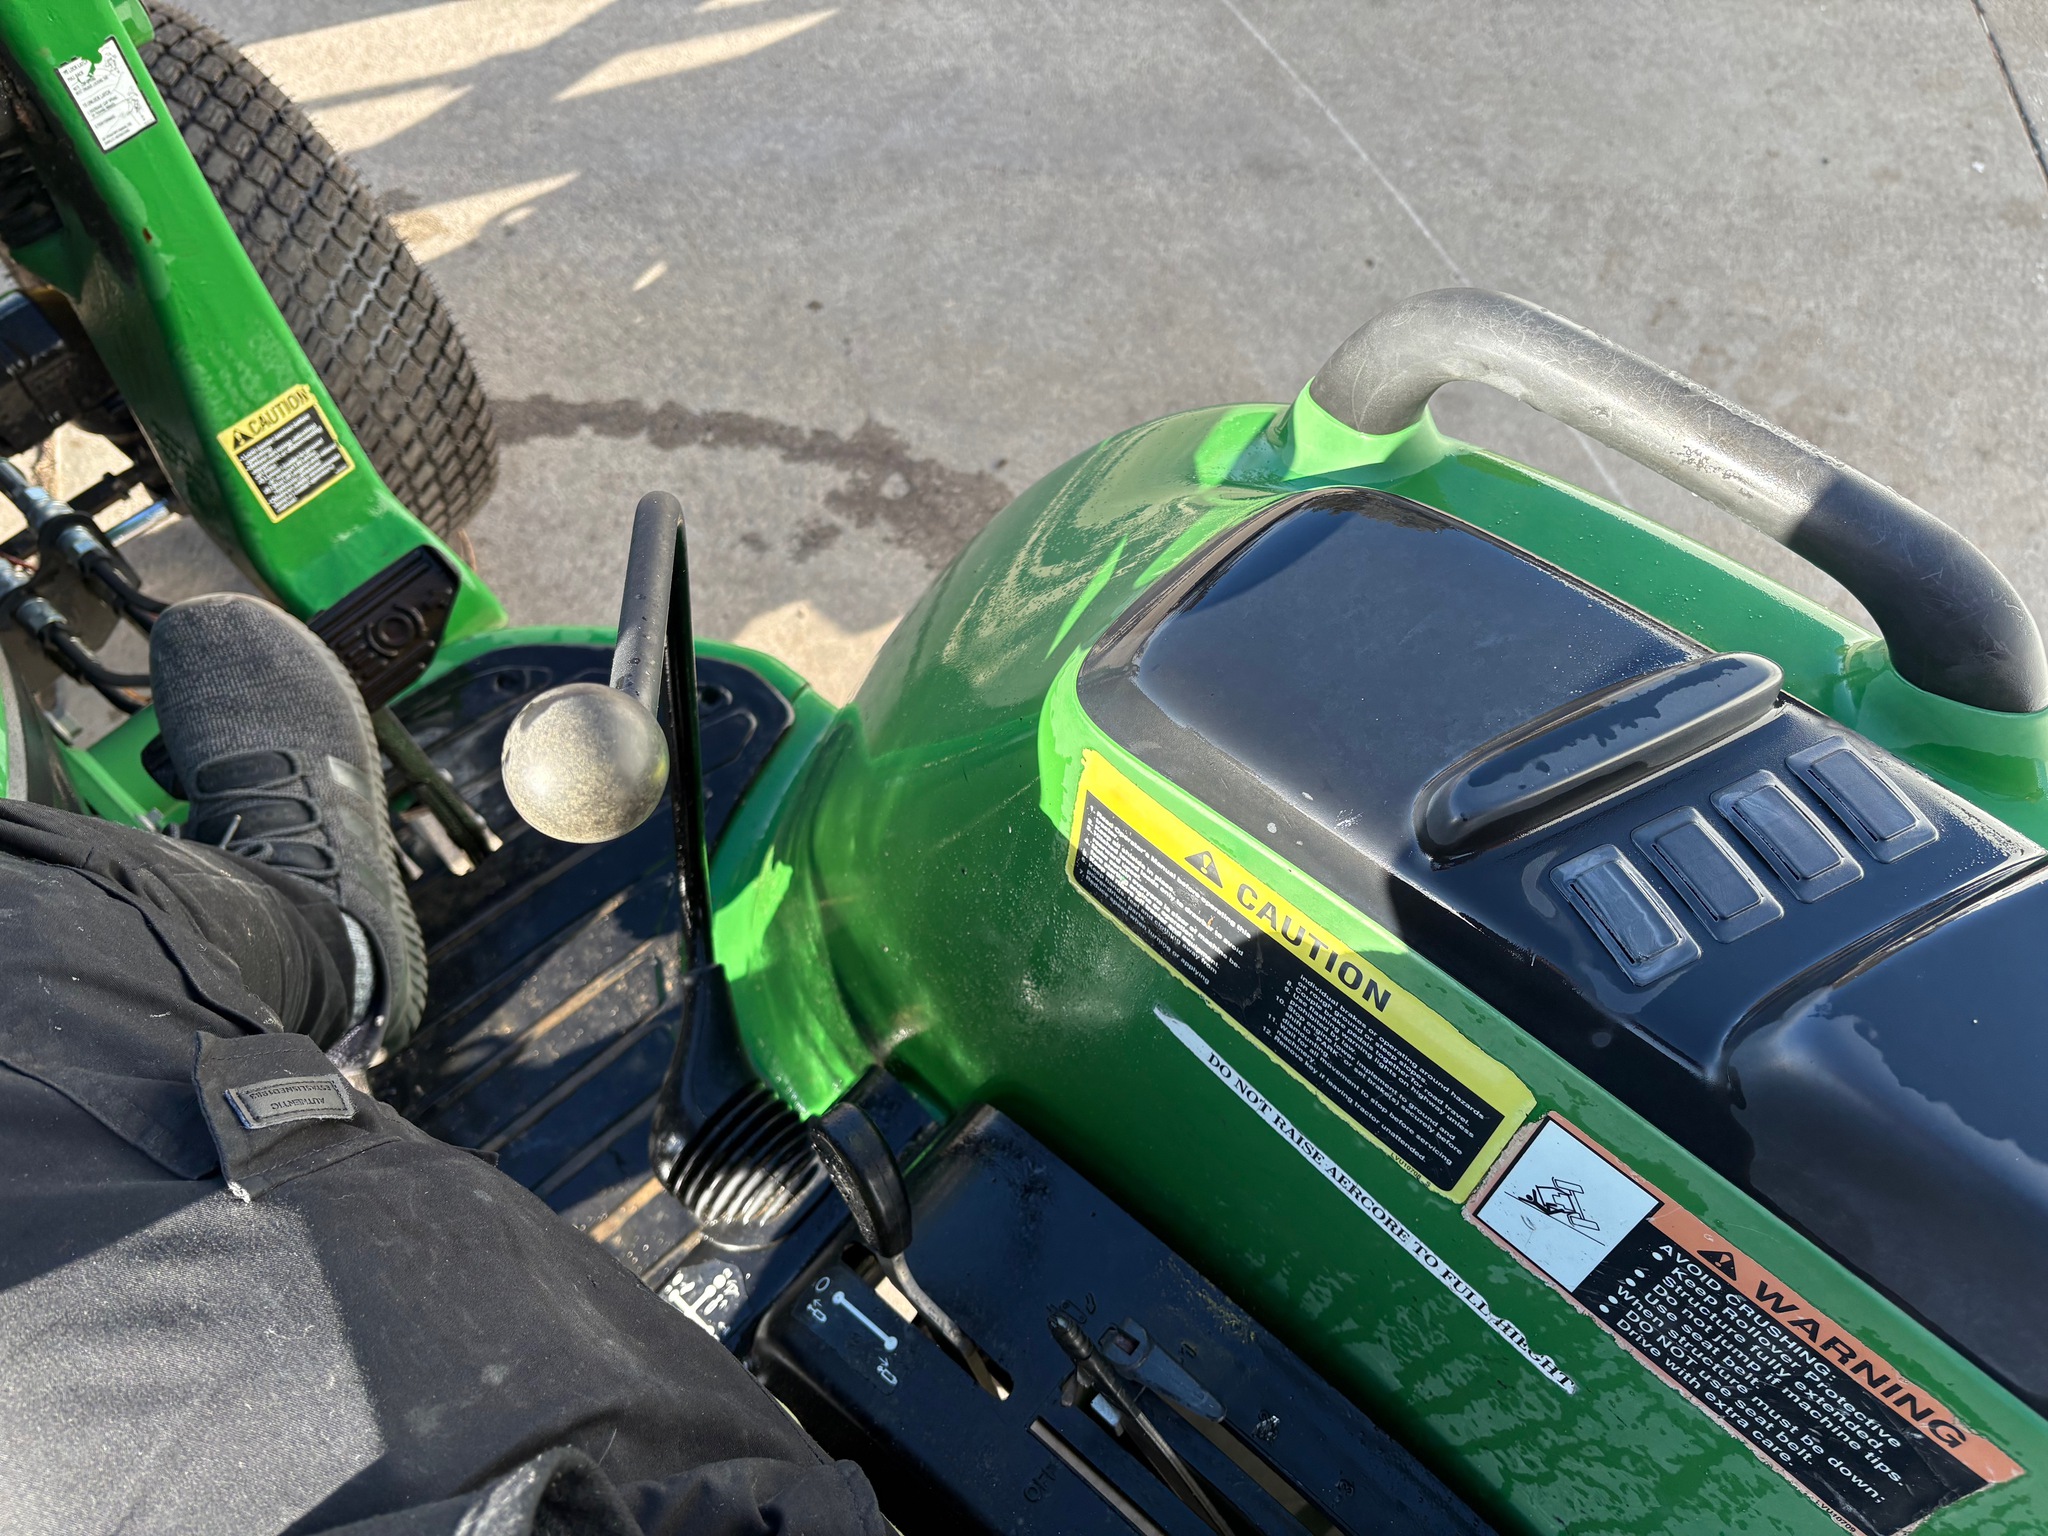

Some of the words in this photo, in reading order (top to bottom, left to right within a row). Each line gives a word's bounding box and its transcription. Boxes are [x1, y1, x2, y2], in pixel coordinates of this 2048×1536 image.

[248, 388, 310, 436] CAUTION
[1087, 862, 1104, 880] Keep
[1140, 907, 1153, 920] and
[1181, 943, 1199, 960] away
[1199, 957, 1218, 974] from
[1109, 895, 1128, 915] speed
[1129, 912, 1147, 930] when
[1180, 957, 1210, 984] applying
[1230, 881, 1394, 1013] CAUTION
[1261, 1025, 1273, 1036] 12.
[1273, 1034, 1304, 1062] Remove
[1303, 1060, 1318, 1074] key
[1325, 1077, 1354, 1103] leaving
[1353, 1100, 1380, 1124] tractor
[1380, 1122, 1427, 1162] unattended.
[1266, 1013, 1278, 1024] 11.
[1278, 1022, 1296, 1039] Wait
[1297, 1037, 1308, 1048] for
[1308, 1047, 1319, 1057] all
[1319, 1055, 1360, 1090] movement
[1369, 1096, 1388, 1114] stop
[1388, 1111, 1415, 1135] before
[1414, 1133, 1453, 1166] servicing
[1274, 994, 1286, 1006] 10.
[1286, 1004, 1306, 1022] Stop
[1305, 1019, 1333, 1044] engine
[1333, 1041, 1355, 1061] lower
[1355, 1059, 1398, 1095] implement
[1407, 1101, 1438, 1127] ground
[1438, 1125, 1455, 1140] and
[1275, 1028, 1317, 1065] machinery.
[1280, 1016, 1331, 1060] dismounting.
[1284, 1010, 1302, 1026] shift
[1353, 1066, 1366, 1078] set
[1366, 1077, 1400, 1106] brake(s)
[1399, 1103, 1435, 1134] securely
[1435, 1132, 1463, 1155] before
[1289, 998, 1329, 1033] prohibited
[1340, 1039, 1358, 1055] law.
[1292, 992, 1308, 1007] Use
[1307, 1005, 1340, 1033] flashing
[1340, 1031, 1373, 1059] warning
[1373, 1056, 1398, 1078] lights
[1409, 1085, 1445, 1116] highway
[1445, 1114, 1474, 1138] unless
[1294, 986, 1323, 1011] Couple
[1323, 1008, 1347, 1029] brake
[1346, 1027, 1375, 1052] pedals
[1374, 1049, 1410, 1079] together
[1409, 1076, 1423, 1089] for
[1423, 1087, 1444, 1105] road
[1443, 1103, 1471, 1126] travel.
[1308, 989, 1333, 1011] rough
[1333, 1008, 1363, 1034] ground
[1373, 1040, 1398, 1061] steep
[1397, 1059, 1429, 1086] slopes.
[1339, 1004, 1367, 1028] brakes
[1377, 1035, 1418, 1069] operating
[1418, 1066, 1450, 1092] around
[1450, 1091, 1485, 1120] hazards
[270, 1098, 325, 1110] AUTHENTIC
[1205, 1053, 1234, 1080] DO
[1232, 1077, 1272, 1116] NOT
[1270, 1113, 1326, 1165] RAISE
[1325, 1163, 1411, 1242] AERCORE
[1411, 1241, 1440, 1269] TO
[1439, 1267, 1493, 1317] FULL
[1643, 1292, 1679, 1322] Use
[1680, 1321, 1721, 1355] seat
[1721, 1355, 1764, 1390] belt.
[1659, 1241, 1722, 1292] AVOID
[1723, 1292, 1837, 1382] CRUSHING:
[1661, 1274, 1748, 1344] Structure
[1747, 1343, 1792, 1380] fully
[1793, 1378, 1887, 1454] extended.
[1669, 1266, 1719, 1307] Keep
[1721, 1305, 1802, 1370] Rollover
[1803, 1370, 1903, 1449] Protective
[1750, 1279, 1969, 1452] WARNING
[1614, 1285, 1666, 1327] When
[1666, 1327, 1749, 1395] structure
[1750, 1394, 1799, 1435] must
[1798, 1433, 1825, 1456] be
[1825, 1455, 1886, 1505] down;
[1615, 1318, 1663, 1357] Drive
[1663, 1356, 1702, 1389] with
[1703, 1389, 1750, 1428] extra
[1750, 1429, 1796, 1467] care.
[1625, 1309, 1654, 1334] DO
[1656, 1334, 1698, 1369] NOT
[1697, 1369, 1732, 1398] use
[1733, 1397, 1775, 1431] seat
[1774, 1430, 1817, 1465] belt.
[1652, 1283, 1680, 1306] Do
[1681, 1306, 1713, 1333] not
[1712, 1333, 1761, 1373] jump
[1764, 1372, 1781, 1387] if
[1781, 1385, 1862, 1451] machine
[1861, 1450, 1907, 1488] tips.
